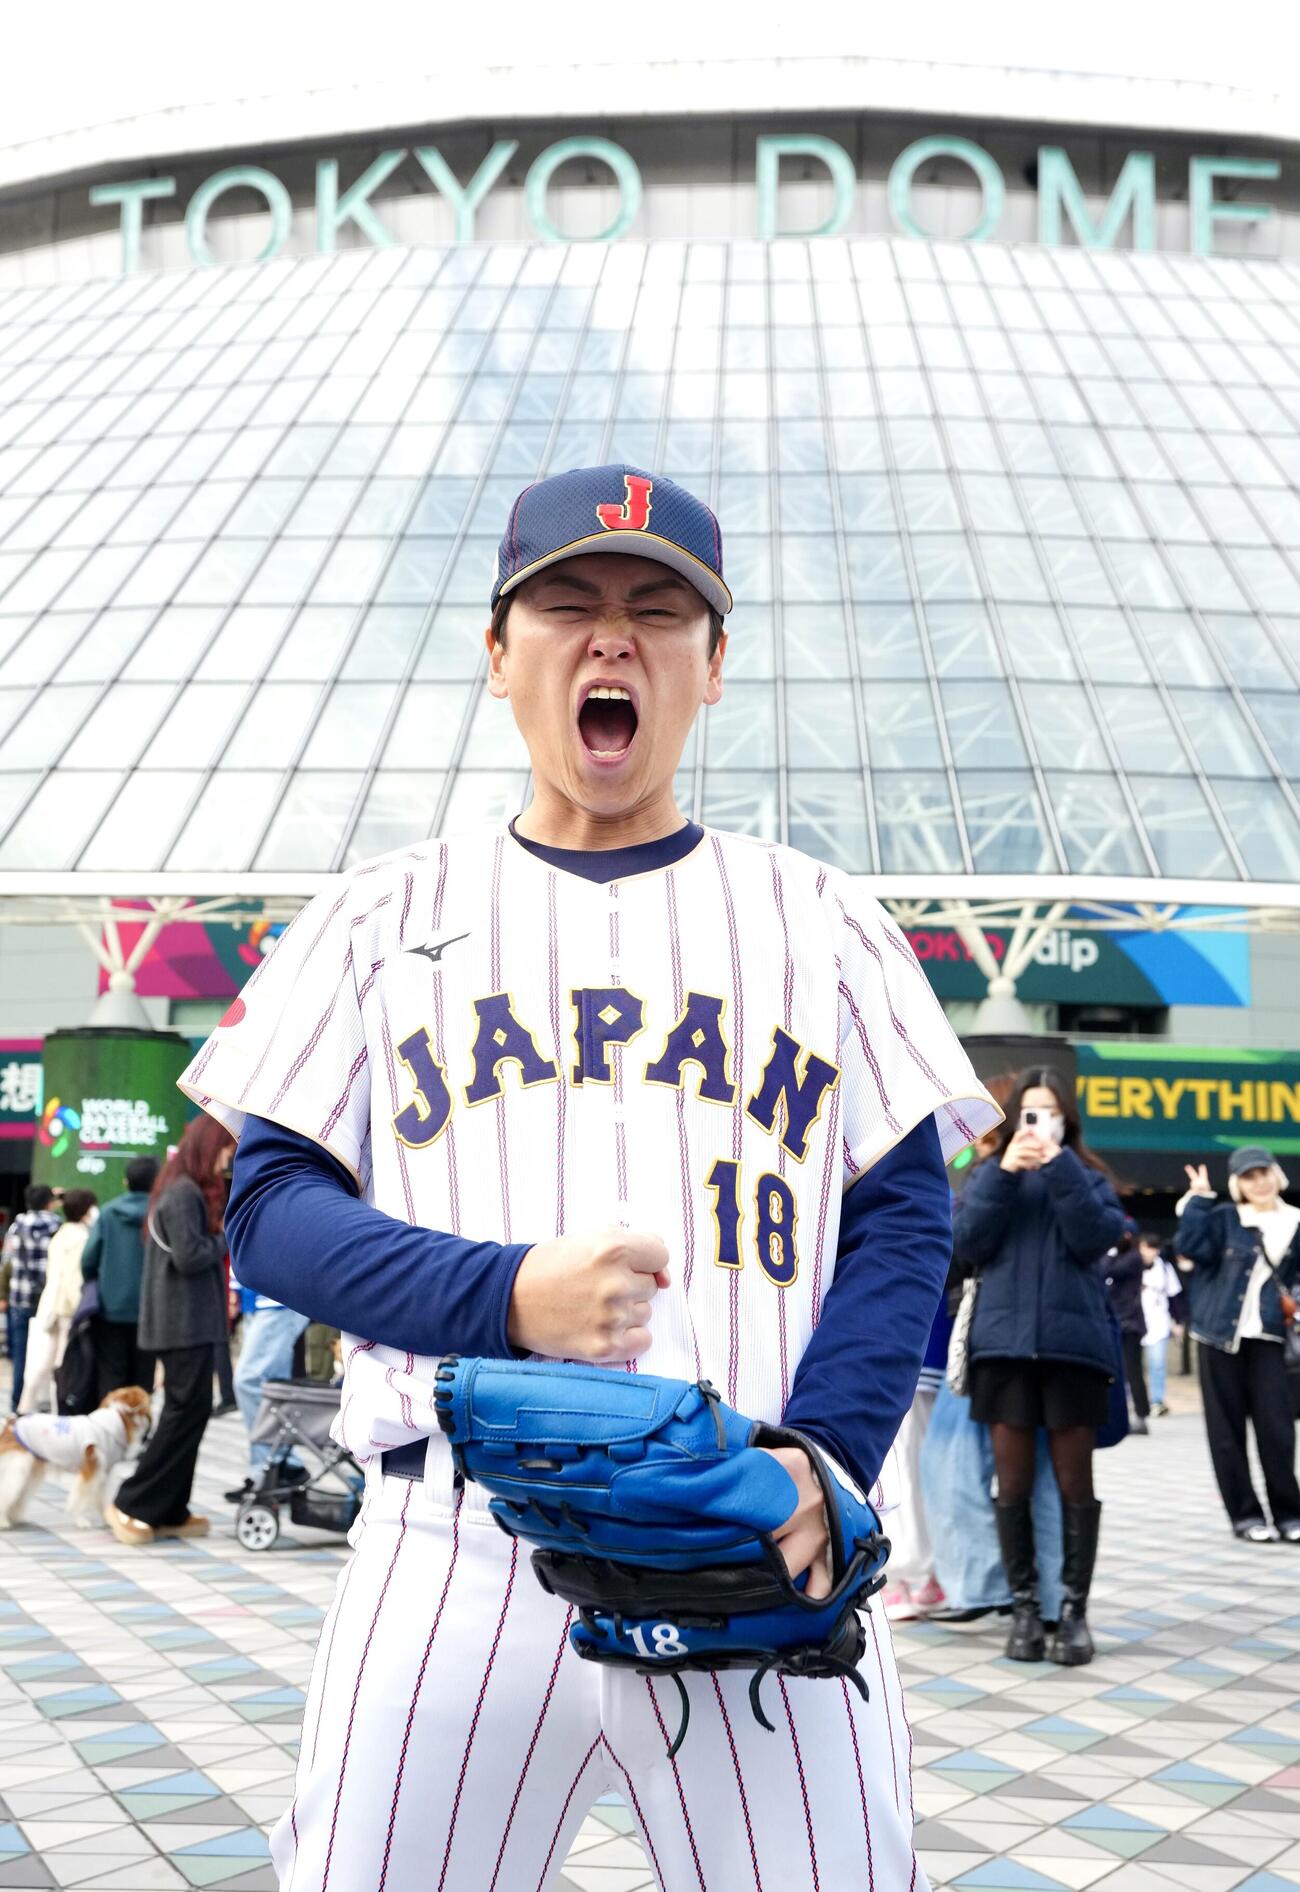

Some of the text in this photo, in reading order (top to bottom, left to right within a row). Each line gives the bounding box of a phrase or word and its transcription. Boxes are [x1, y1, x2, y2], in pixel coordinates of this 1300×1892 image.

[90, 135, 643, 274] TOKYO
[596, 474, 652, 530] J
[1034, 930, 1099, 972] dip
[391, 987, 842, 1164] JAPAN
[704, 1156, 800, 1288] 18
[625, 1622, 689, 1658] 18
